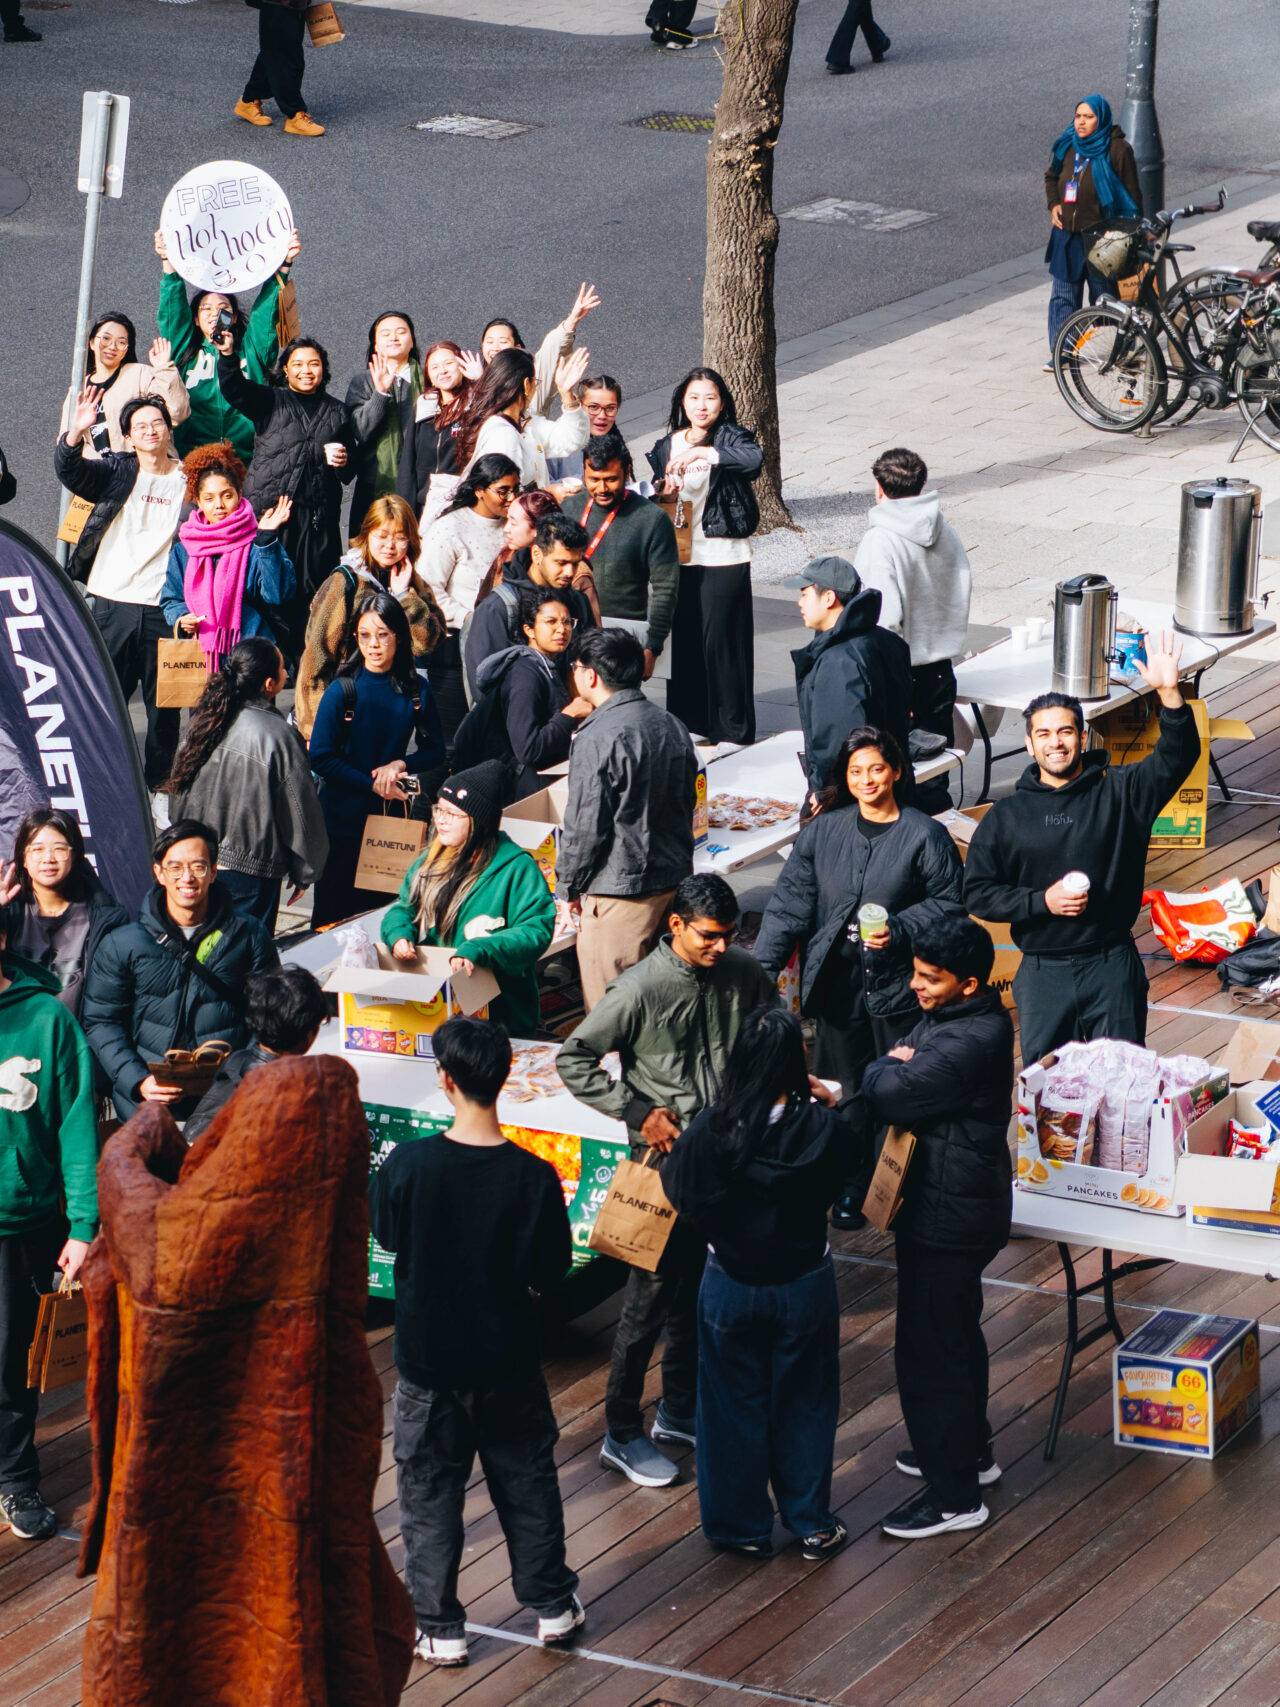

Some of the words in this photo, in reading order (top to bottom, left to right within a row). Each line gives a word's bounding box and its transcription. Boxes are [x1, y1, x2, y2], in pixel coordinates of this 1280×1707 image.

[177, 176, 261, 216] FREE
[366, 838, 416, 852] PLANETUNI
[1067, 1185, 1119, 1200] PANCAKES
[612, 1191, 673, 1220] PLANETUNI
[1124, 1369, 1170, 1383] FAVOURITES
[1181, 1374, 1201, 1388] 66
